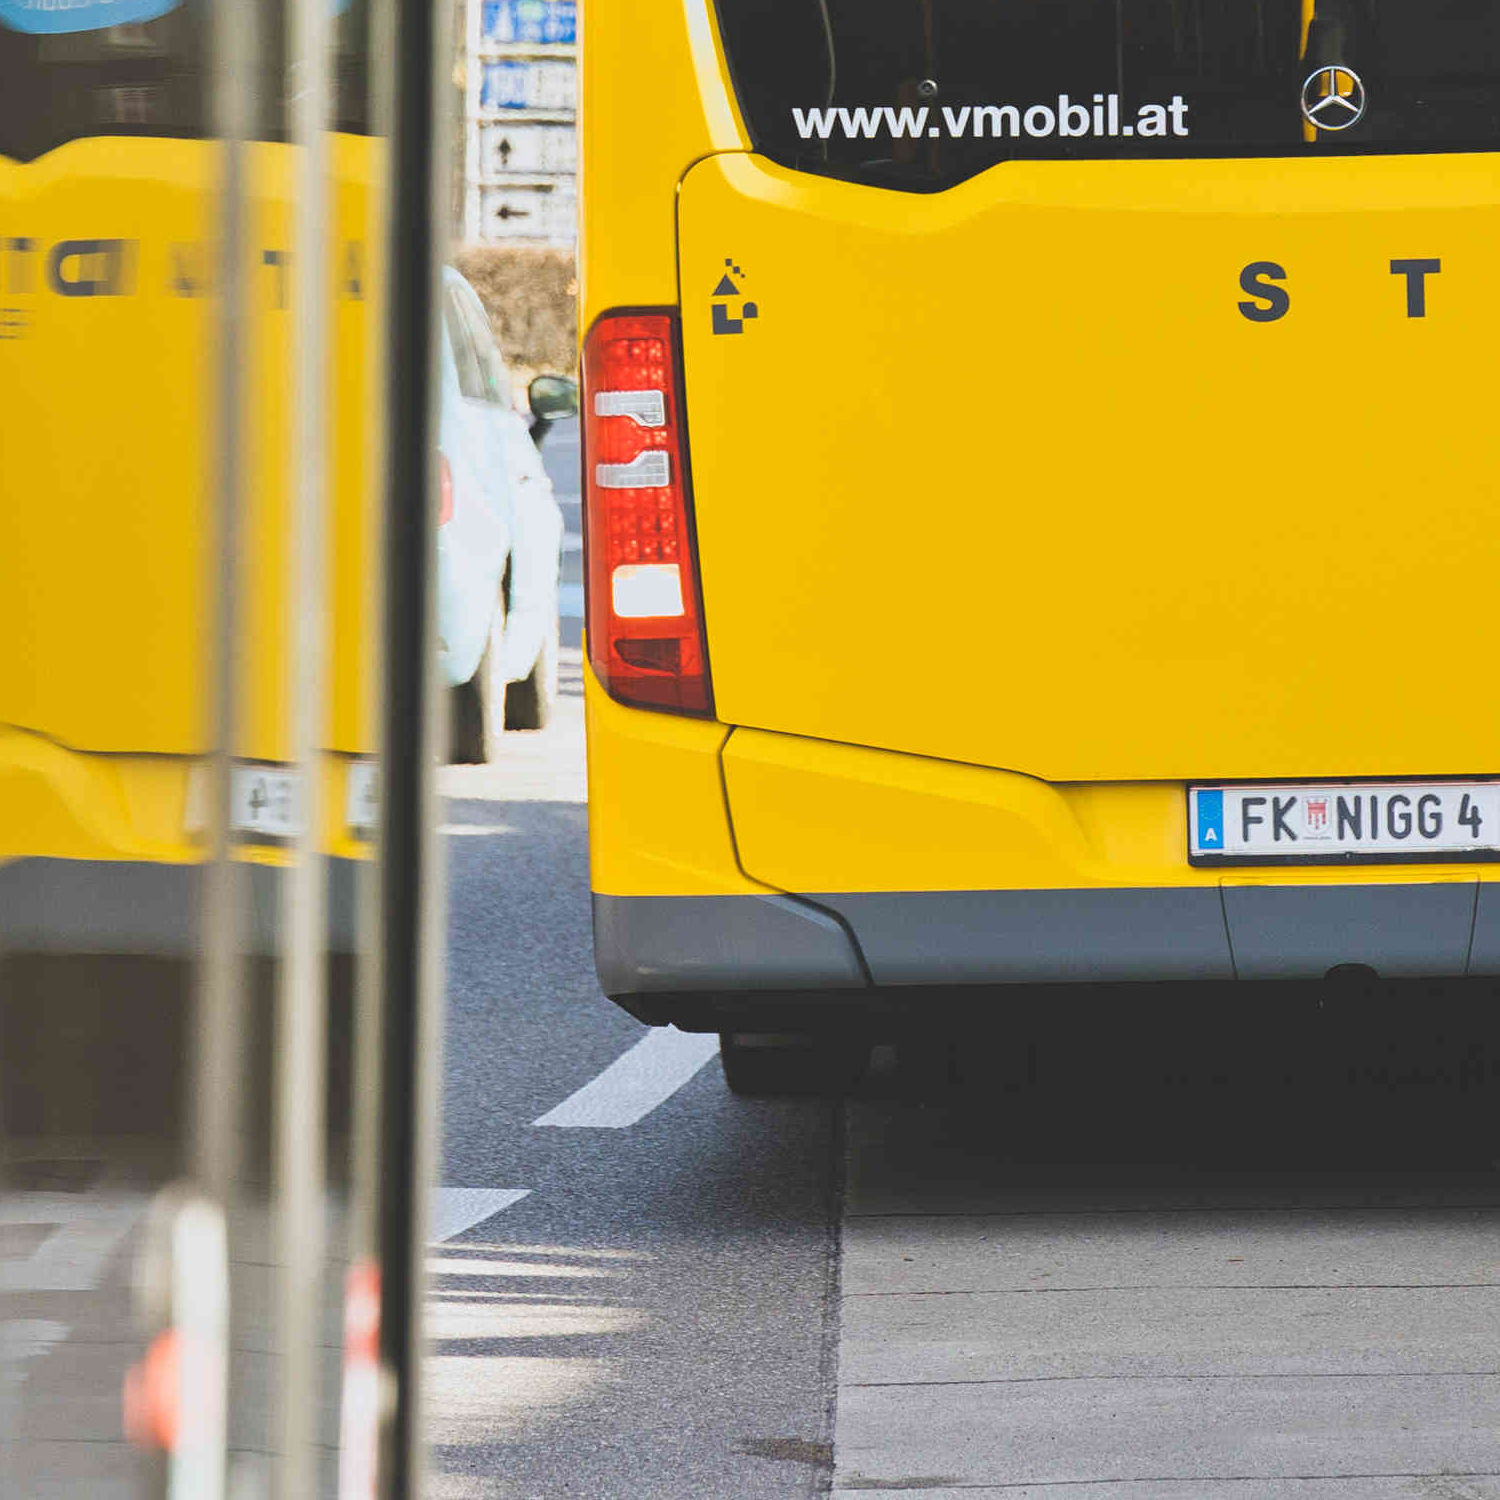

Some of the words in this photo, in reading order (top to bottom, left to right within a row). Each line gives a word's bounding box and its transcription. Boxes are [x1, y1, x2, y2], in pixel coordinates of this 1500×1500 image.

[791, 93, 1190, 139] www.vmobil.at
[1203, 827, 1218, 842] A
[1241, 795, 1299, 843] FK
[1336, 793, 1443, 841] NIGG
[1457, 792, 1484, 839] 4
